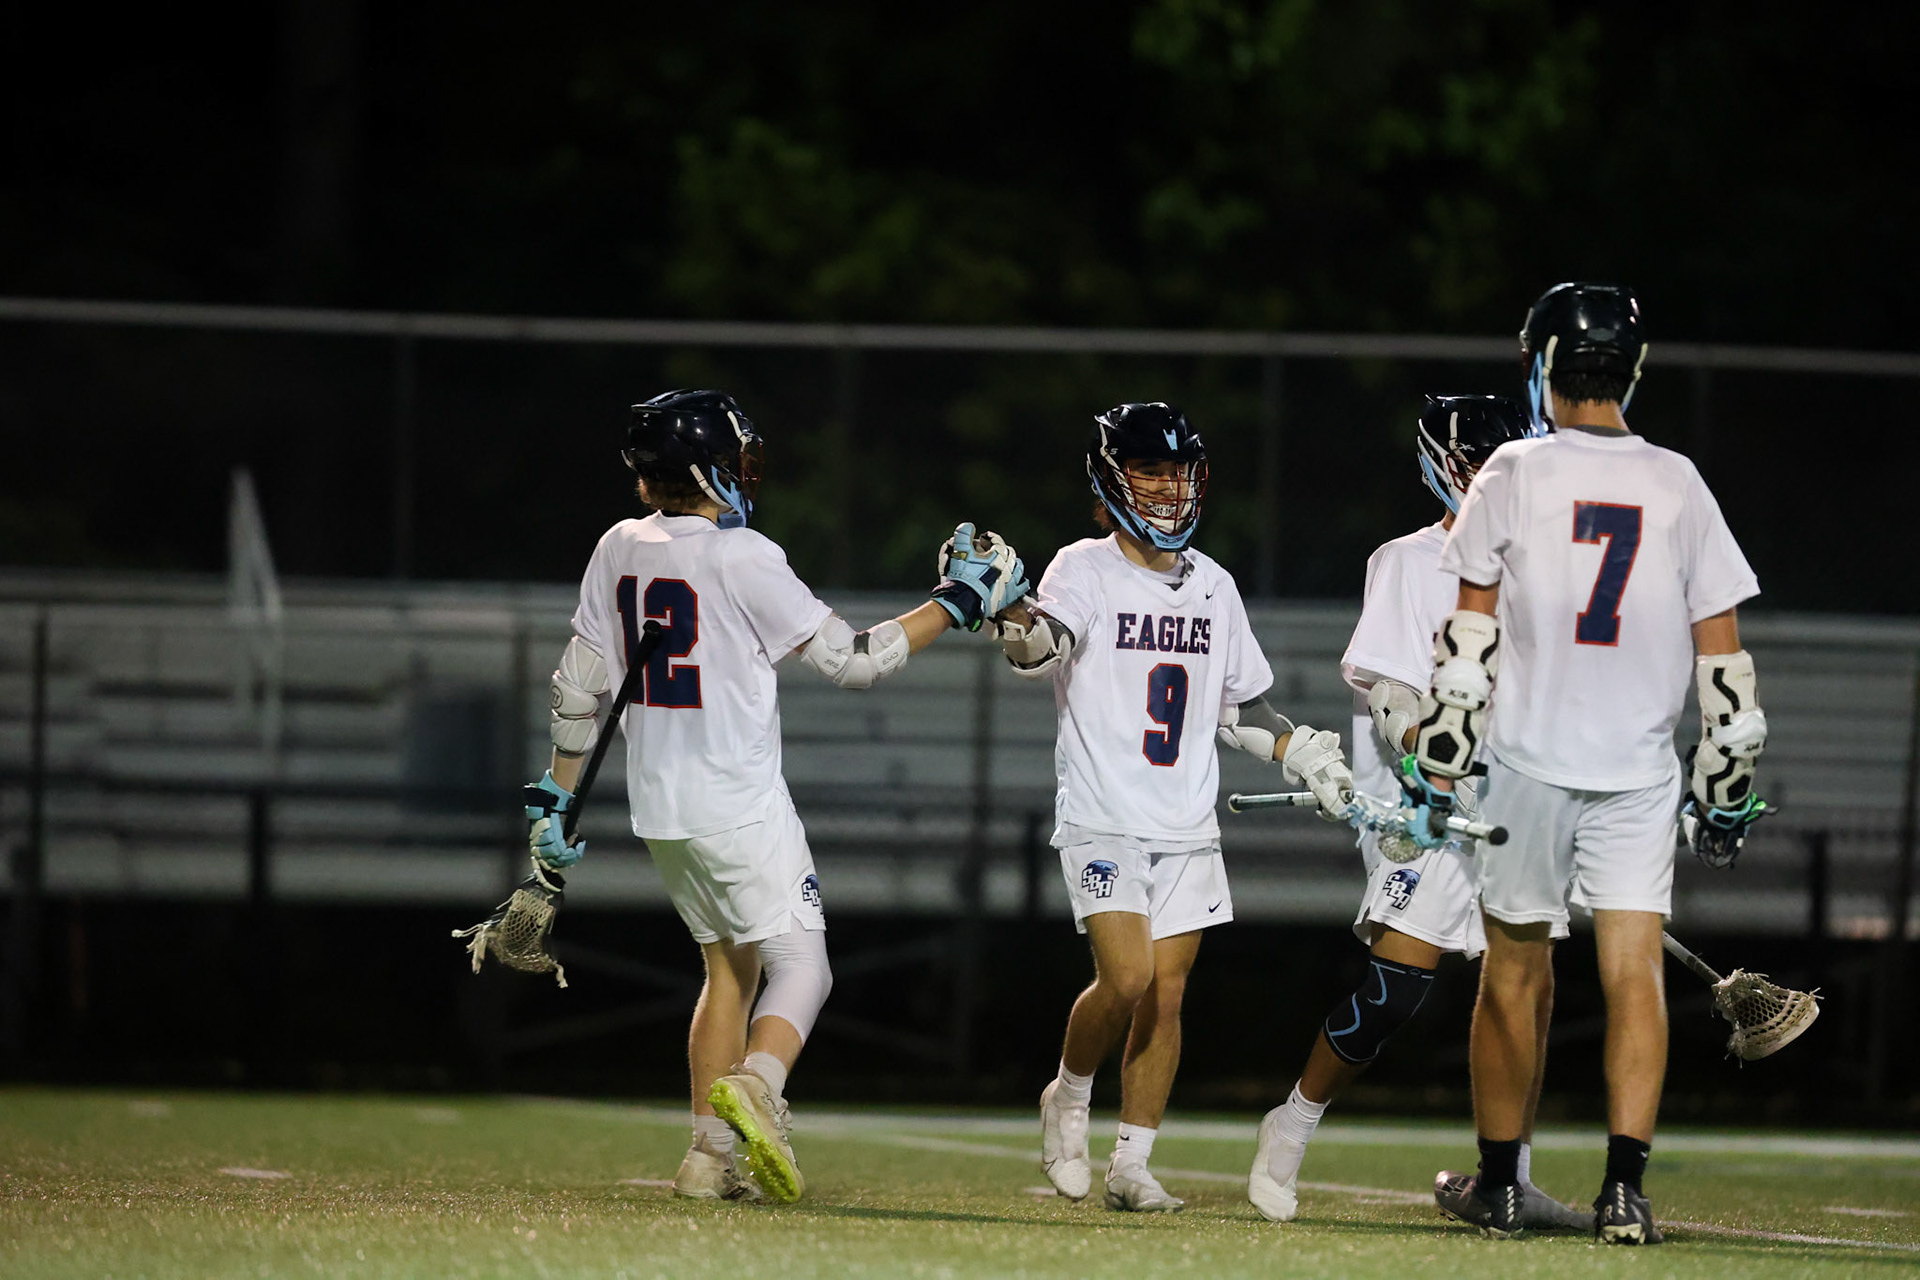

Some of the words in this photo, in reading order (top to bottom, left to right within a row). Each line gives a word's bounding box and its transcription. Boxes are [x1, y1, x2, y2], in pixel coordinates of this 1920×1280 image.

[1572, 500, 1643, 647] 7
[616, 575, 702, 709] 12
[1116, 613, 1211, 655] EAGLES
[1143, 663, 1189, 767] 9
[801, 882, 824, 915] SB
